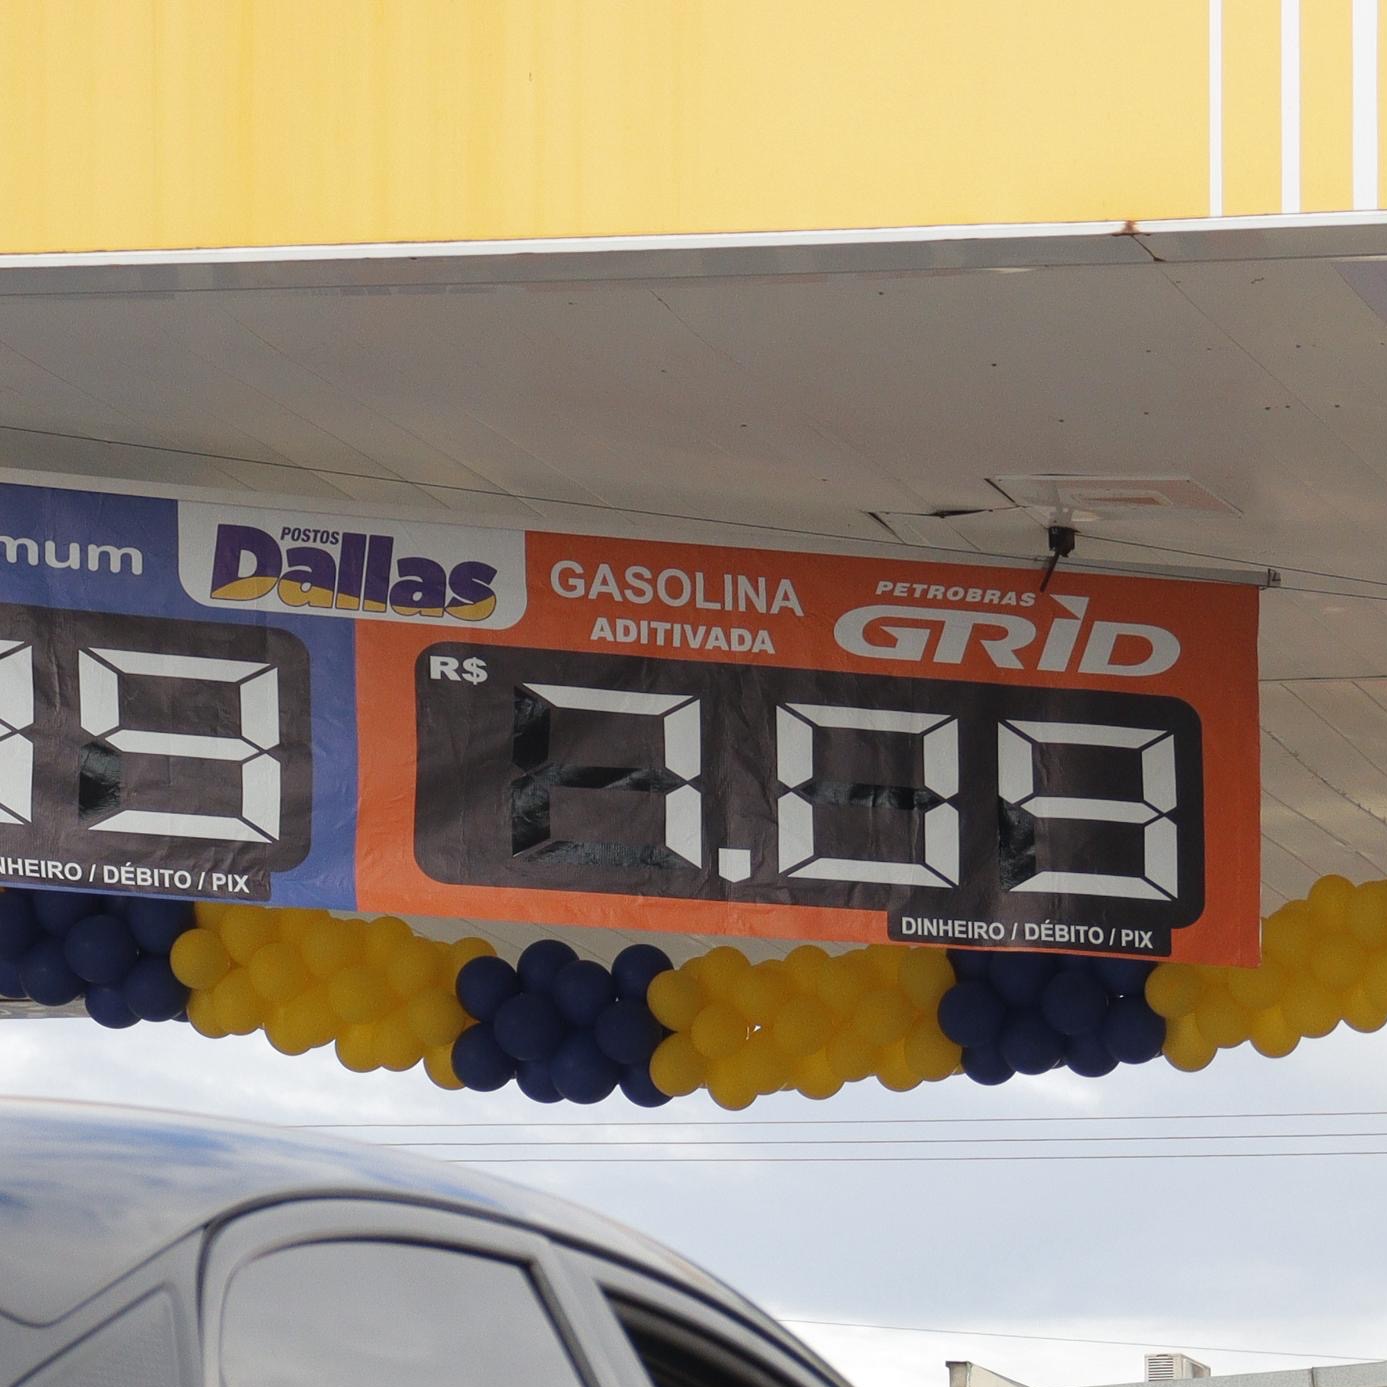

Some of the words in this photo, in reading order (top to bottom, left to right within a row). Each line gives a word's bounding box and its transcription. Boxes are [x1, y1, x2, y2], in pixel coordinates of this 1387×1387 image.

[280, 526, 340, 546] POSTOS
[210, 523, 498, 622] Dallas
[549, 558, 804, 617] GASOLINA
[875, 580, 1036, 606] PETROBRAS
[590, 616, 776, 654] ADITIVADA
[833, 594, 1181, 676] GRID
[429, 655, 488, 684] R$
[103, 862, 192, 889] DÉBITO
[212, 873, 250, 893] PIX
[901, 916, 1005, 940] DINHEIRO
[1024, 919, 1104, 945] DÉBITO
[1121, 929, 1154, 949] PIX
